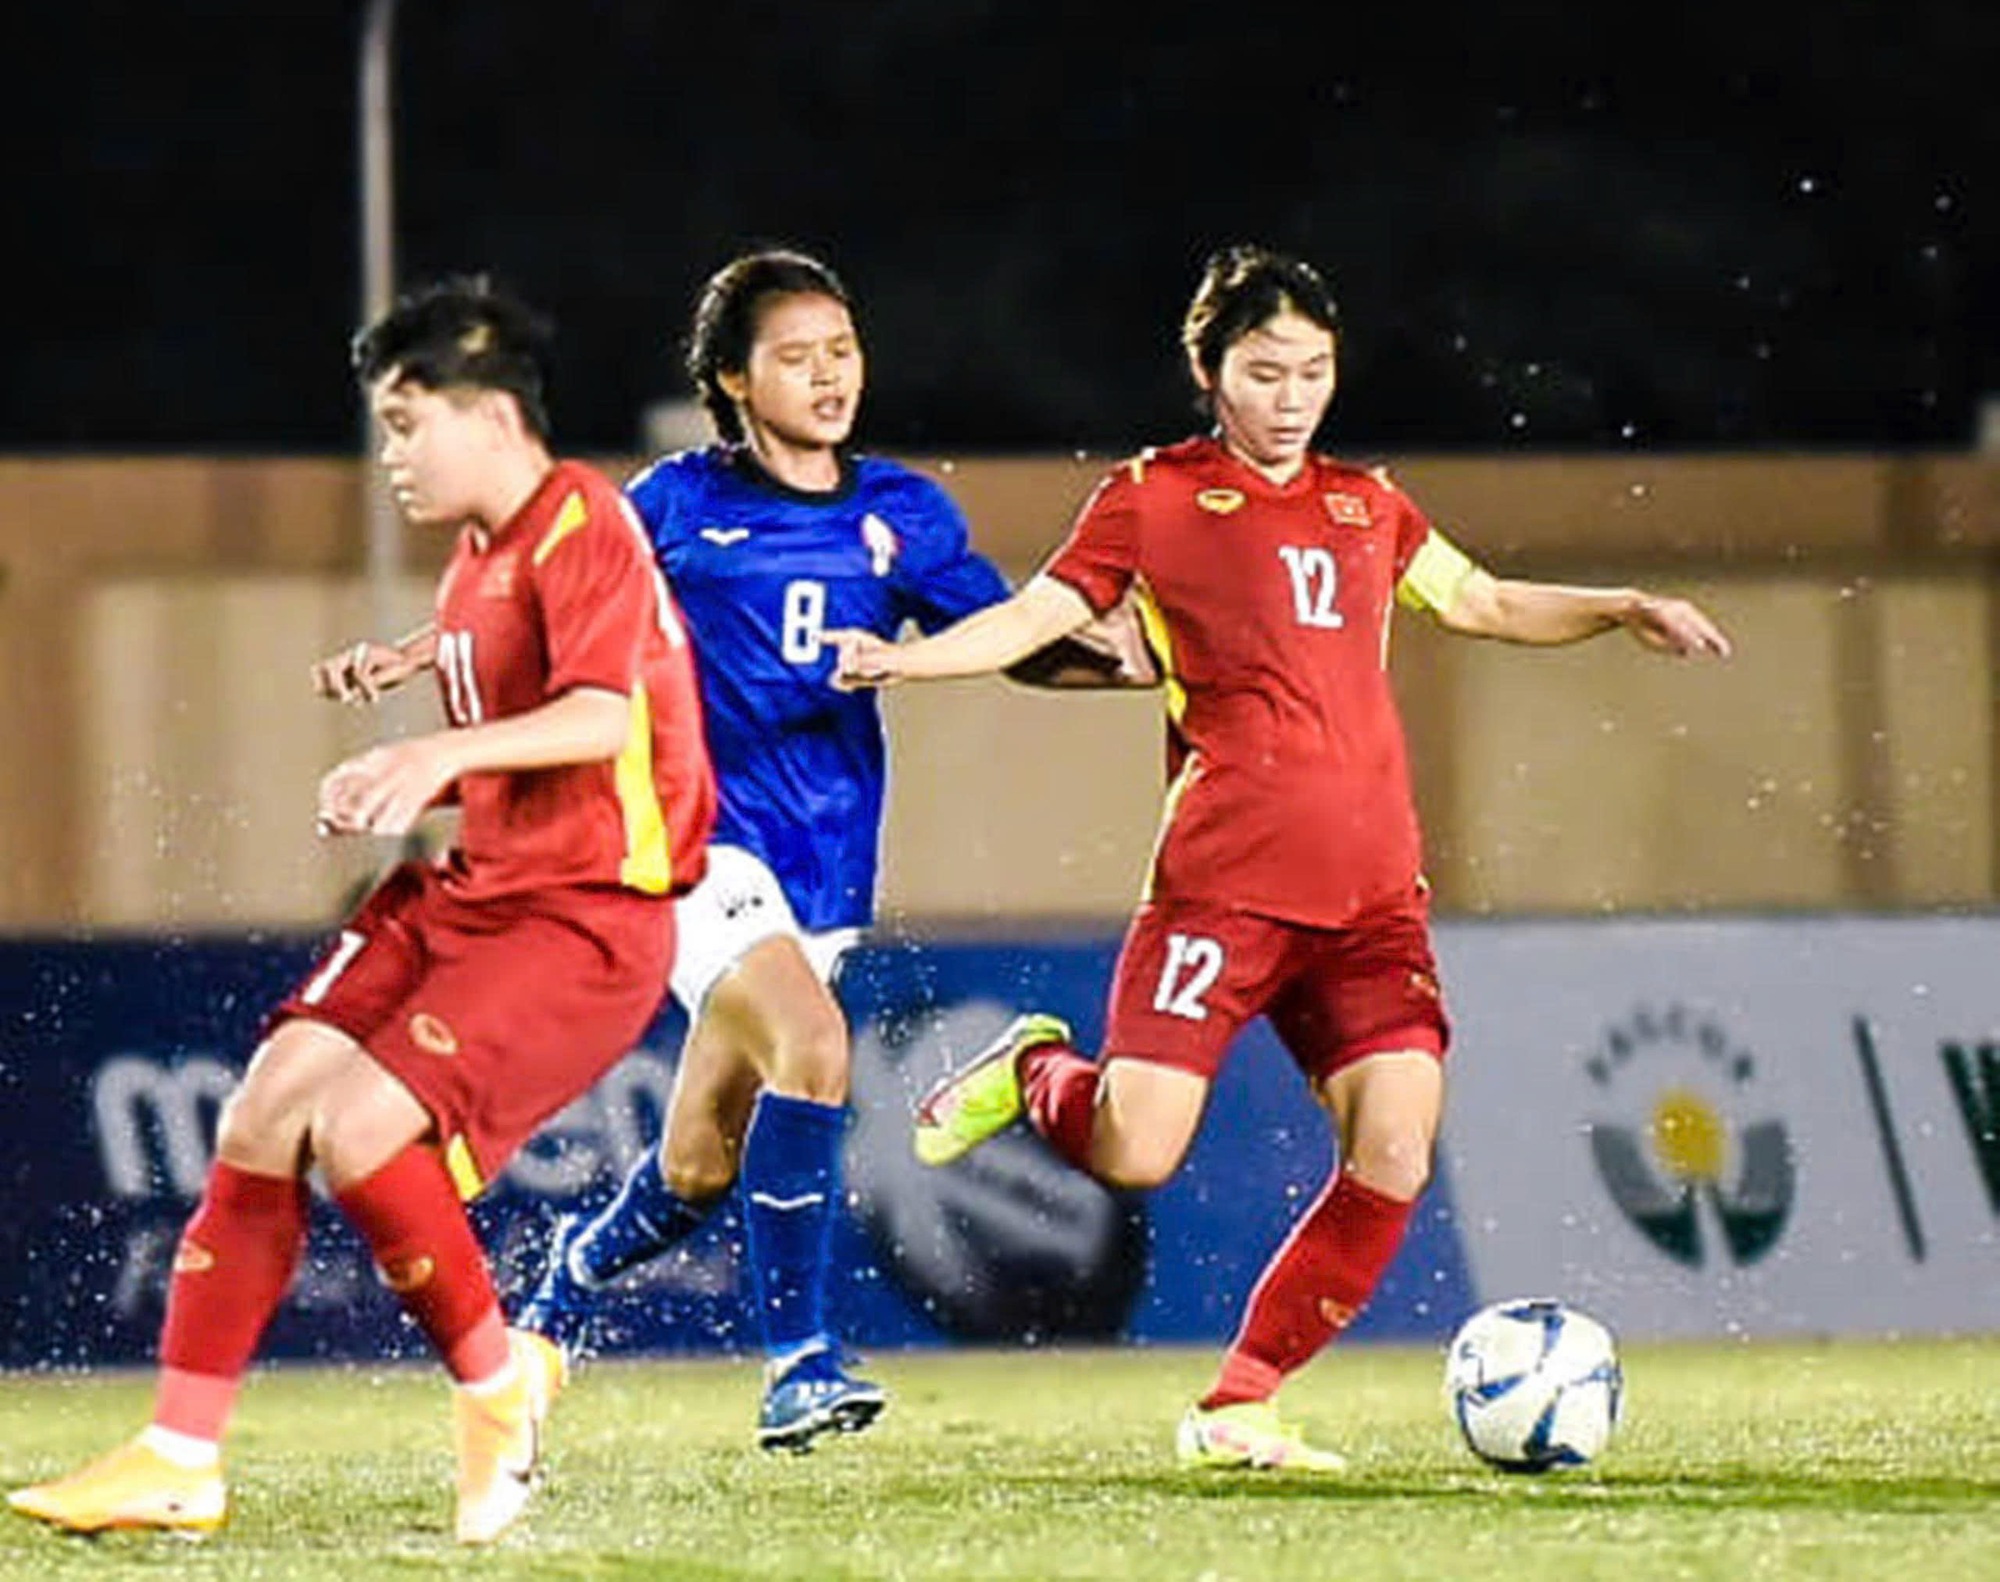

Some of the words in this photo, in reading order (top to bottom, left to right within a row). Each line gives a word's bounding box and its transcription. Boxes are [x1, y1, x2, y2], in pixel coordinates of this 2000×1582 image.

[783, 579, 825, 664] 8
[1278, 546, 1344, 629] 12
[1152, 932, 1224, 1020] 12
